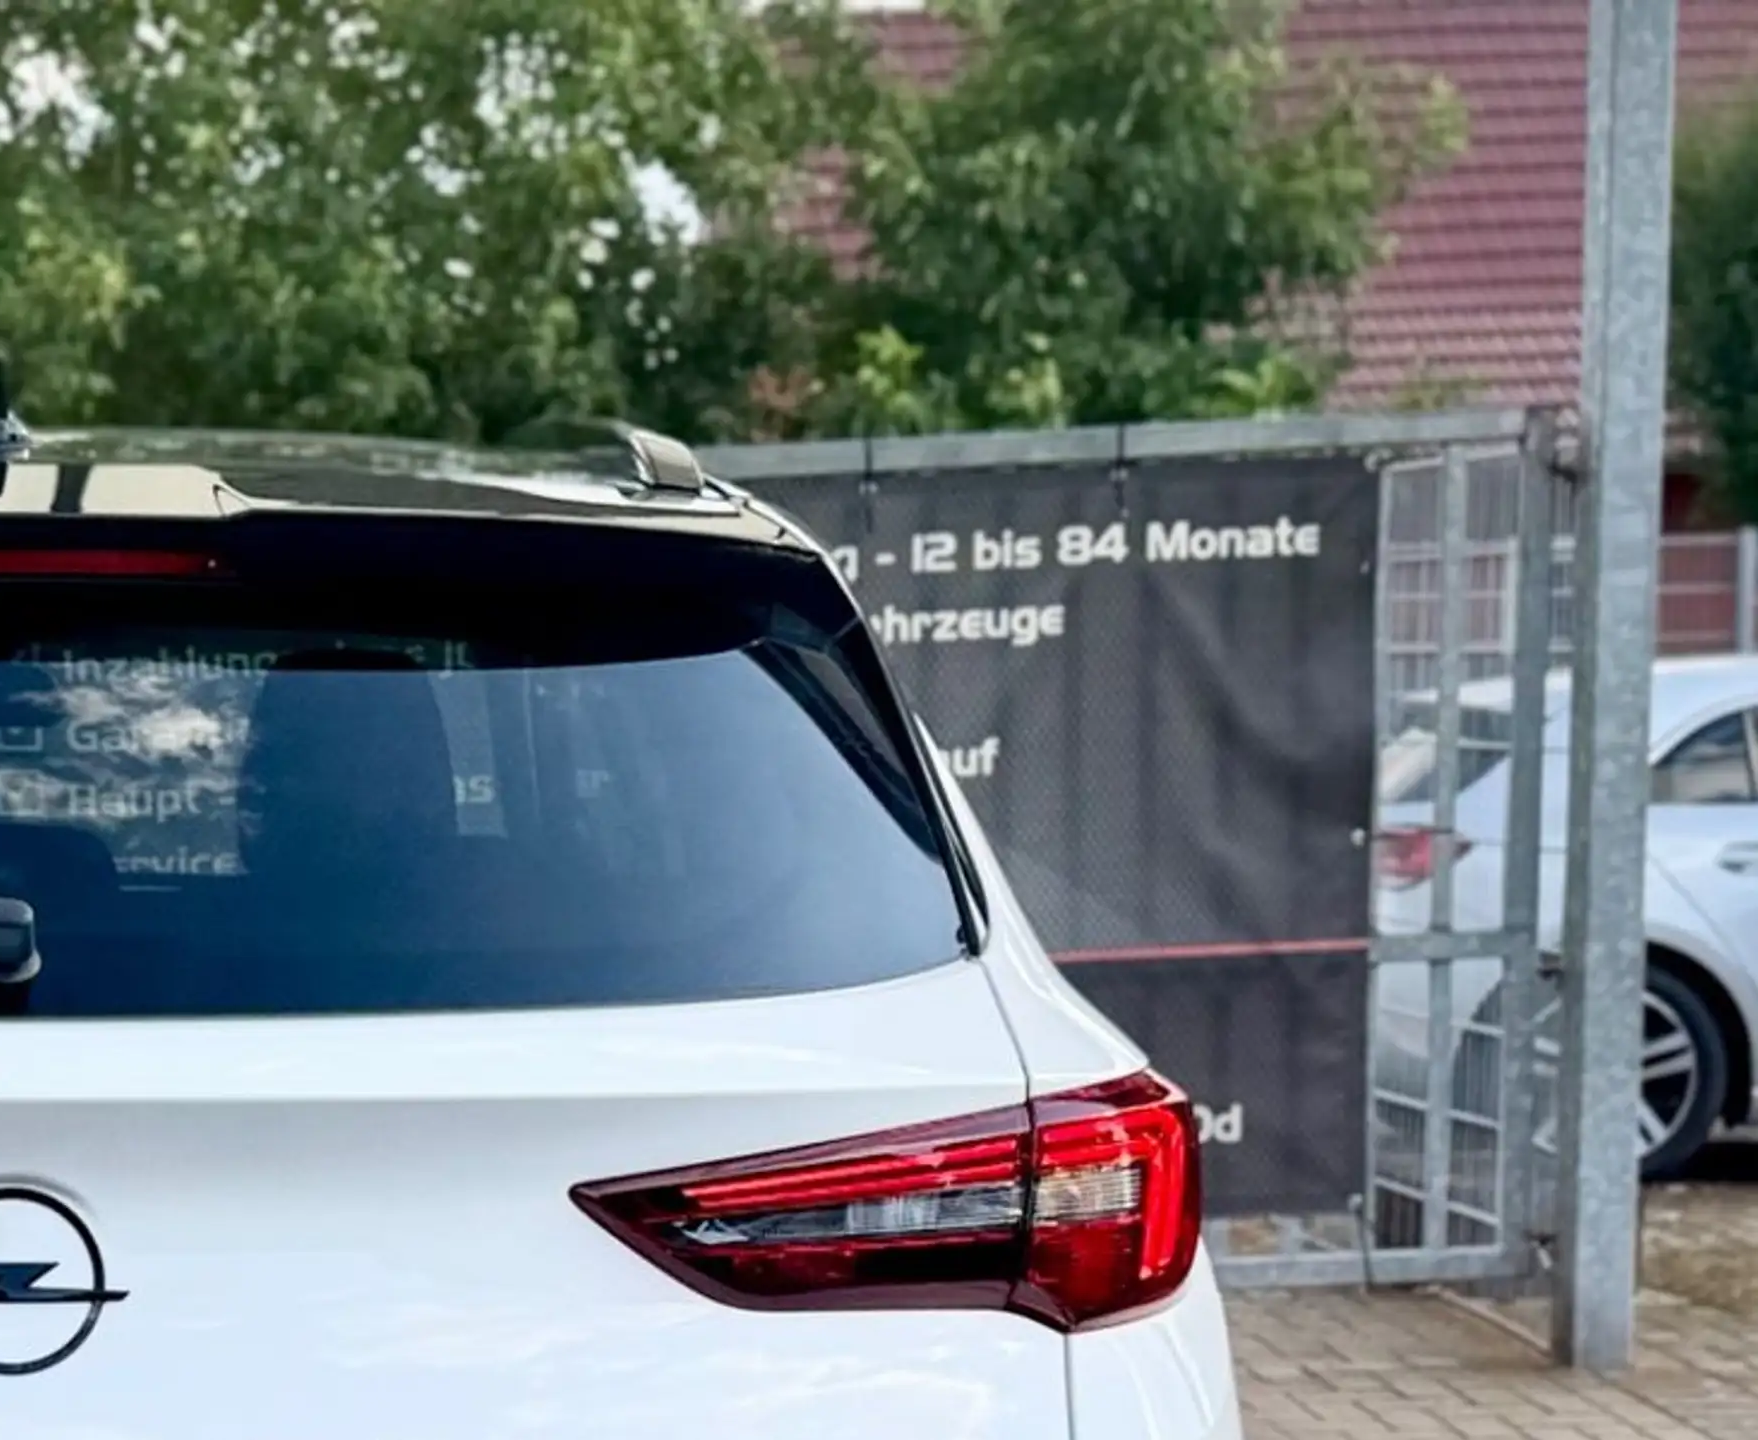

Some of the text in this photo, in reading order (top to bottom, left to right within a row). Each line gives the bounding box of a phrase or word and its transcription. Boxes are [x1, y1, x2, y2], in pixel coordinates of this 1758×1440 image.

[911, 531, 958, 574] 12
[973, 528, 1042, 571] bis
[1057, 523, 1129, 566] 84
[1145, 515, 1321, 562] Monate
[870, 605, 1066, 647] hrzeuge
